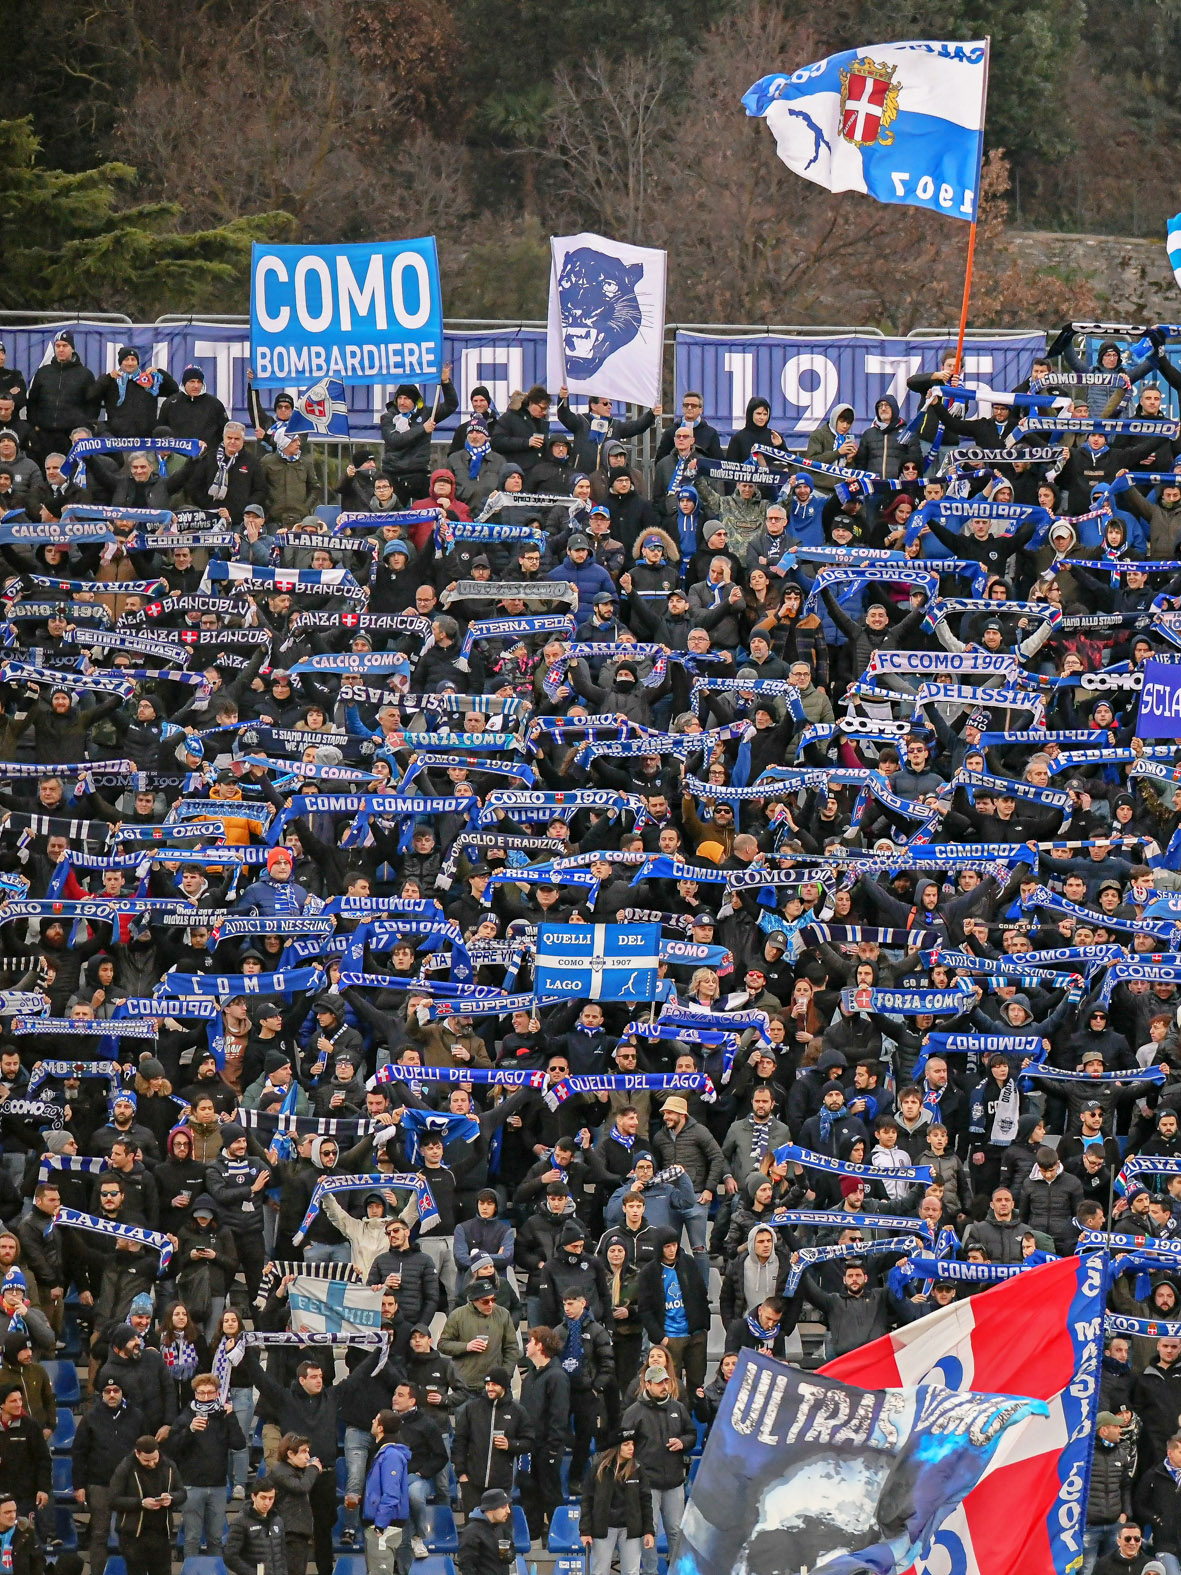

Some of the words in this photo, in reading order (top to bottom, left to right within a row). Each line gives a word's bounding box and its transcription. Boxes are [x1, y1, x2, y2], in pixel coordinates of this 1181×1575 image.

[256, 251, 431, 333] COMO
[256, 342, 437, 379] BOMBARDIERE
[1042, 373, 1079, 386] COMO
[1082, 373, 1112, 386] 1907
[1020, 418, 1097, 433] VARESE
[1102, 420, 1125, 434] TI
[1130, 421, 1176, 435] ODIO
[954, 448, 1020, 461] COMO
[1024, 447, 1064, 460] 1907
[12, 524, 66, 536] CALCIO
[70, 524, 106, 534] COMO
[449, 524, 490, 540] FORZA
[492, 525, 529, 539] COMO
[147, 534, 197, 546] COMO
[200, 532, 232, 545] 1907
[287, 533, 360, 550] LARIANI
[859, 549, 890, 558] COMO
[866, 570, 930, 582] COMO
[474, 620, 531, 636] ETERNA
[534, 616, 570, 630] FEDE
[312, 655, 360, 667] CALCIO
[363, 655, 404, 666] COMO
[879, 654, 900, 670] FC
[908, 654, 963, 670] COMO
[971, 654, 1014, 670] 1907
[1081, 673, 1143, 691] COMO
[279, 730, 302, 742] SIAMO
[303, 732, 322, 743] ALLO
[322, 734, 348, 745] STADIO
[412, 733, 461, 746] FORZA
[464, 732, 505, 746] COMO
[78, 760, 130, 773] FEDE
[417, 754, 459, 766] COMO
[484, 760, 521, 772] 1907
[491, 792, 545, 804] COMO
[575, 792, 618, 804] 1907
[173, 820, 225, 836] COMO
[553, 852, 600, 868] CALCIO
[604, 851, 646, 862] COMO
[730, 868, 796, 887] COMO
[225, 921, 262, 933] AMICI
[266, 922, 277, 932] DI
[542, 933, 592, 946] QUELLI
[618, 934, 645, 946] DEL
[667, 942, 708, 957] COMO
[1013, 948, 1070, 964] COMO
[1076, 944, 1116, 957] 1907
[944, 954, 980, 969] AMICI
[1000, 962, 1056, 978] NESSUNO
[340, 972, 390, 986] COMO
[456, 983, 500, 996] 1907
[545, 978, 582, 990] LAGO
[876, 992, 921, 1008] FORZA
[394, 1064, 440, 1080] QUELLI
[450, 1068, 474, 1082] DEL
[488, 1070, 524, 1084] LAGO
[570, 1075, 616, 1090] QUELLI
[625, 1074, 650, 1088] DEL
[662, 1073, 700, 1088] LAGO
[800, 1150, 840, 1170] LET'S
[844, 1161, 865, 1172] GO
[868, 1165, 916, 1178] BLUES
[864, 1215, 923, 1229] FEDE
[1084, 1232, 1127, 1244] COMO
[731, 1362, 906, 1450] ULTRAS
